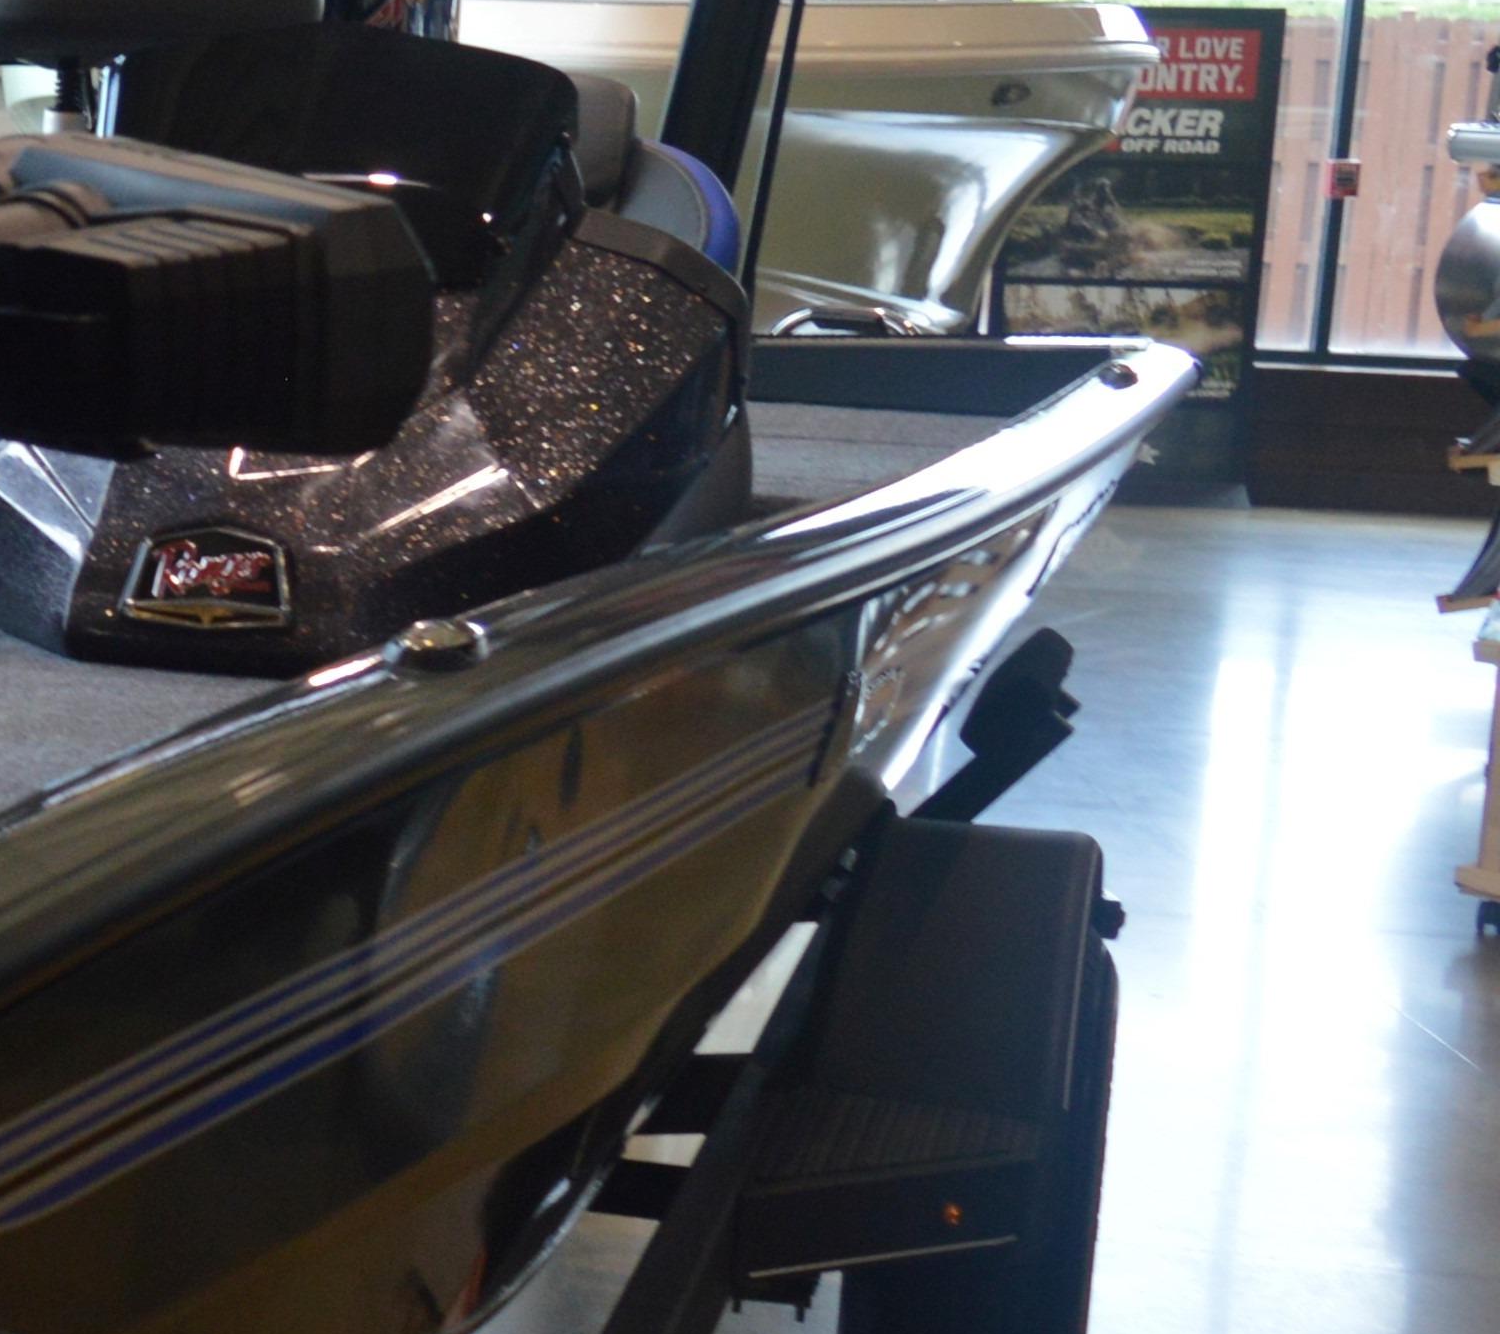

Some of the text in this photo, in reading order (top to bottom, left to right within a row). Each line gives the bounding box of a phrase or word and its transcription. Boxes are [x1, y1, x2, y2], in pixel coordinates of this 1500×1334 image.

[1179, 36, 1245, 61] LOVE
[1137, 62, 1245, 94] UNTRY.
[1120, 107, 1225, 138] CKER
[1121, 138, 1220, 154] OFF ROAD
